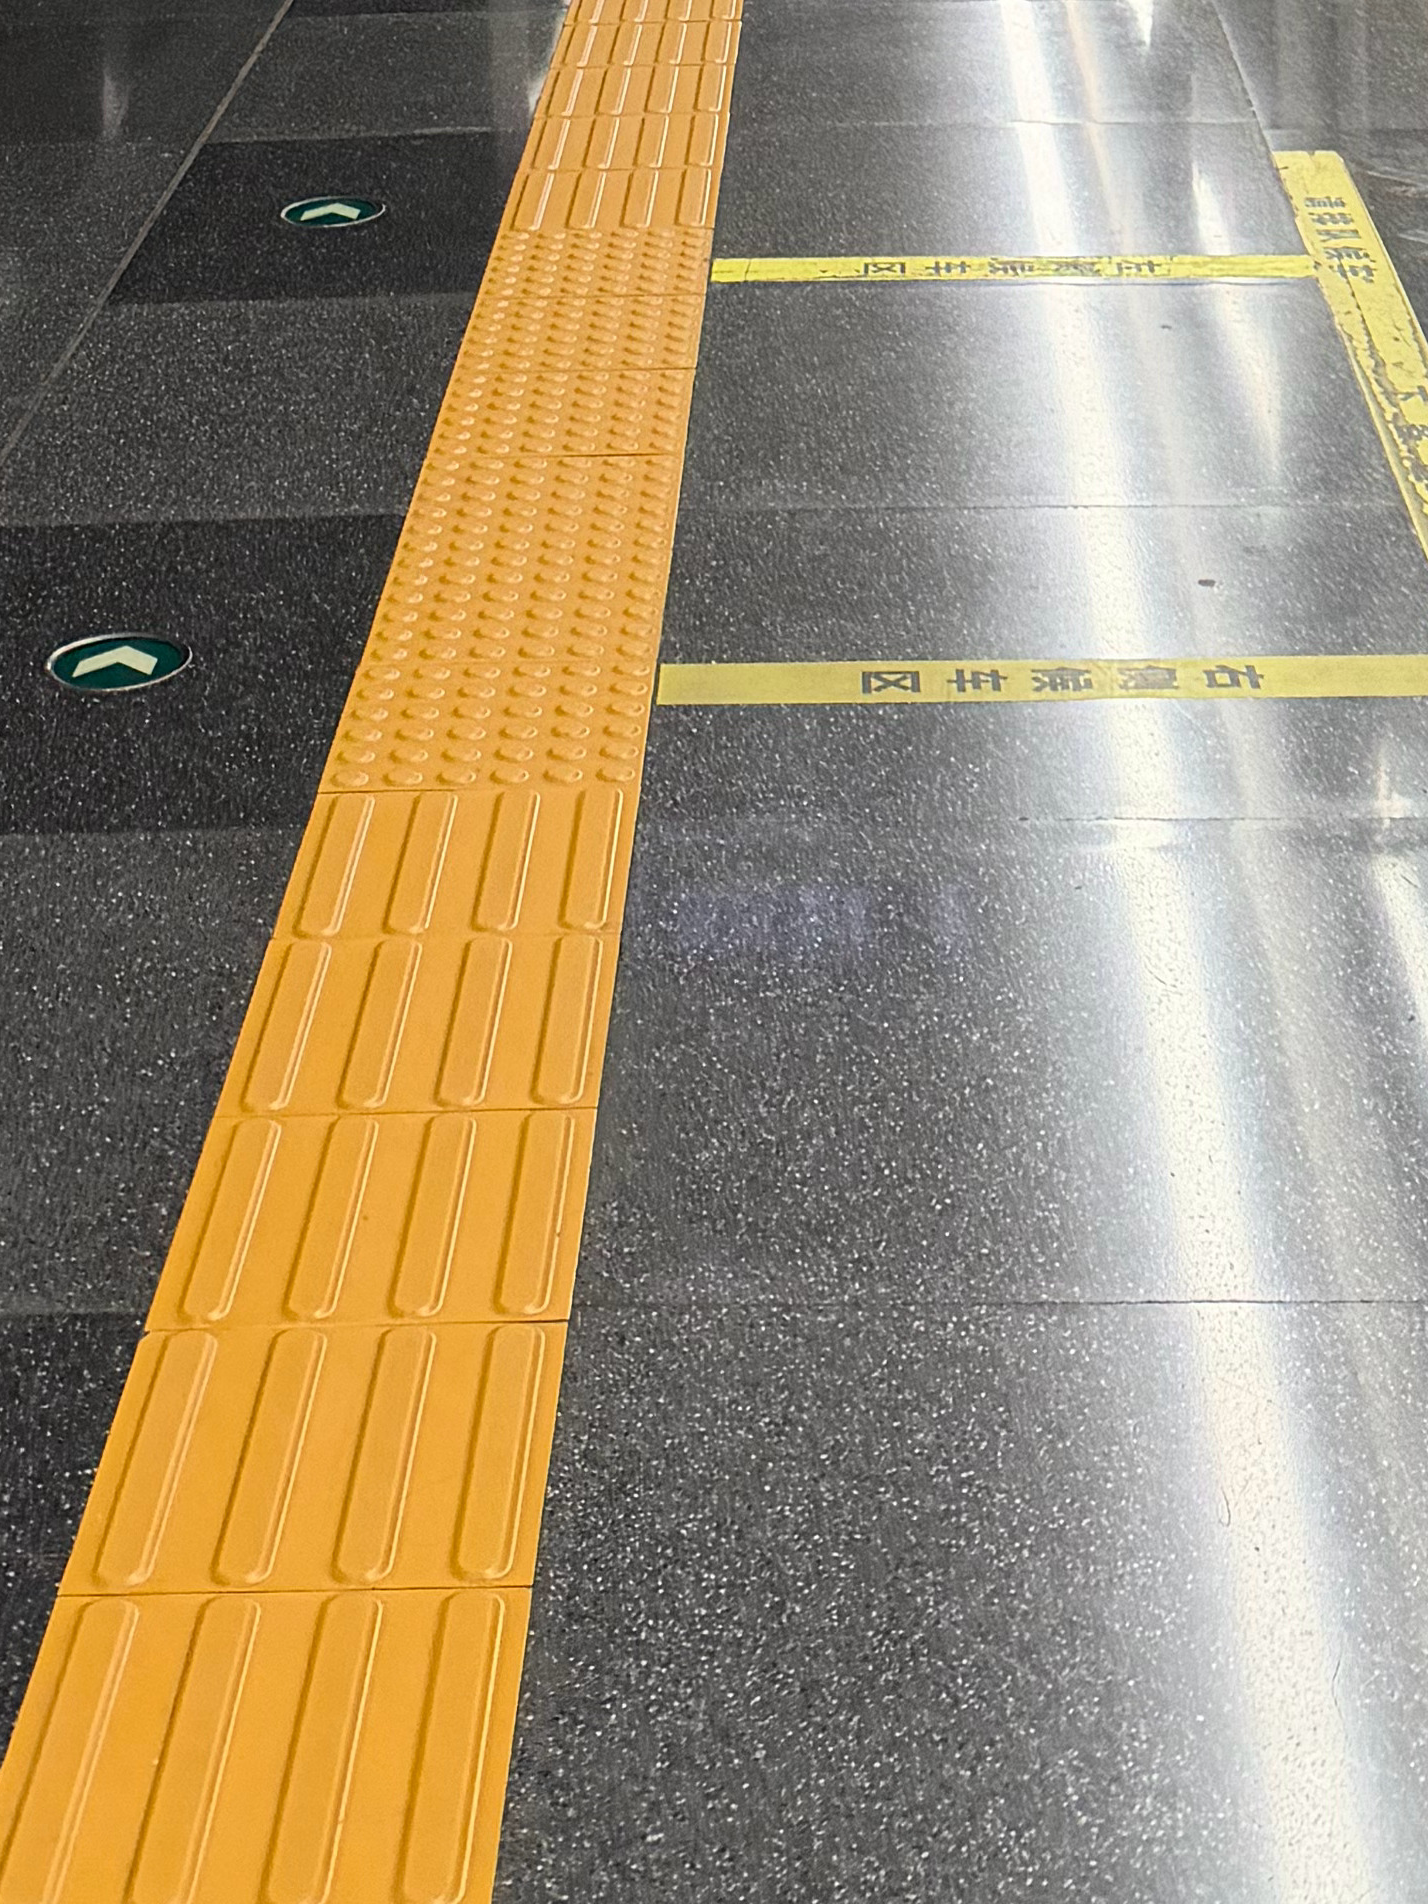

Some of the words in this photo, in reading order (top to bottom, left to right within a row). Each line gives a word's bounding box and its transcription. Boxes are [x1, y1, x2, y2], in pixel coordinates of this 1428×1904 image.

[861, 664, 1264, 694] 右侧候车区
